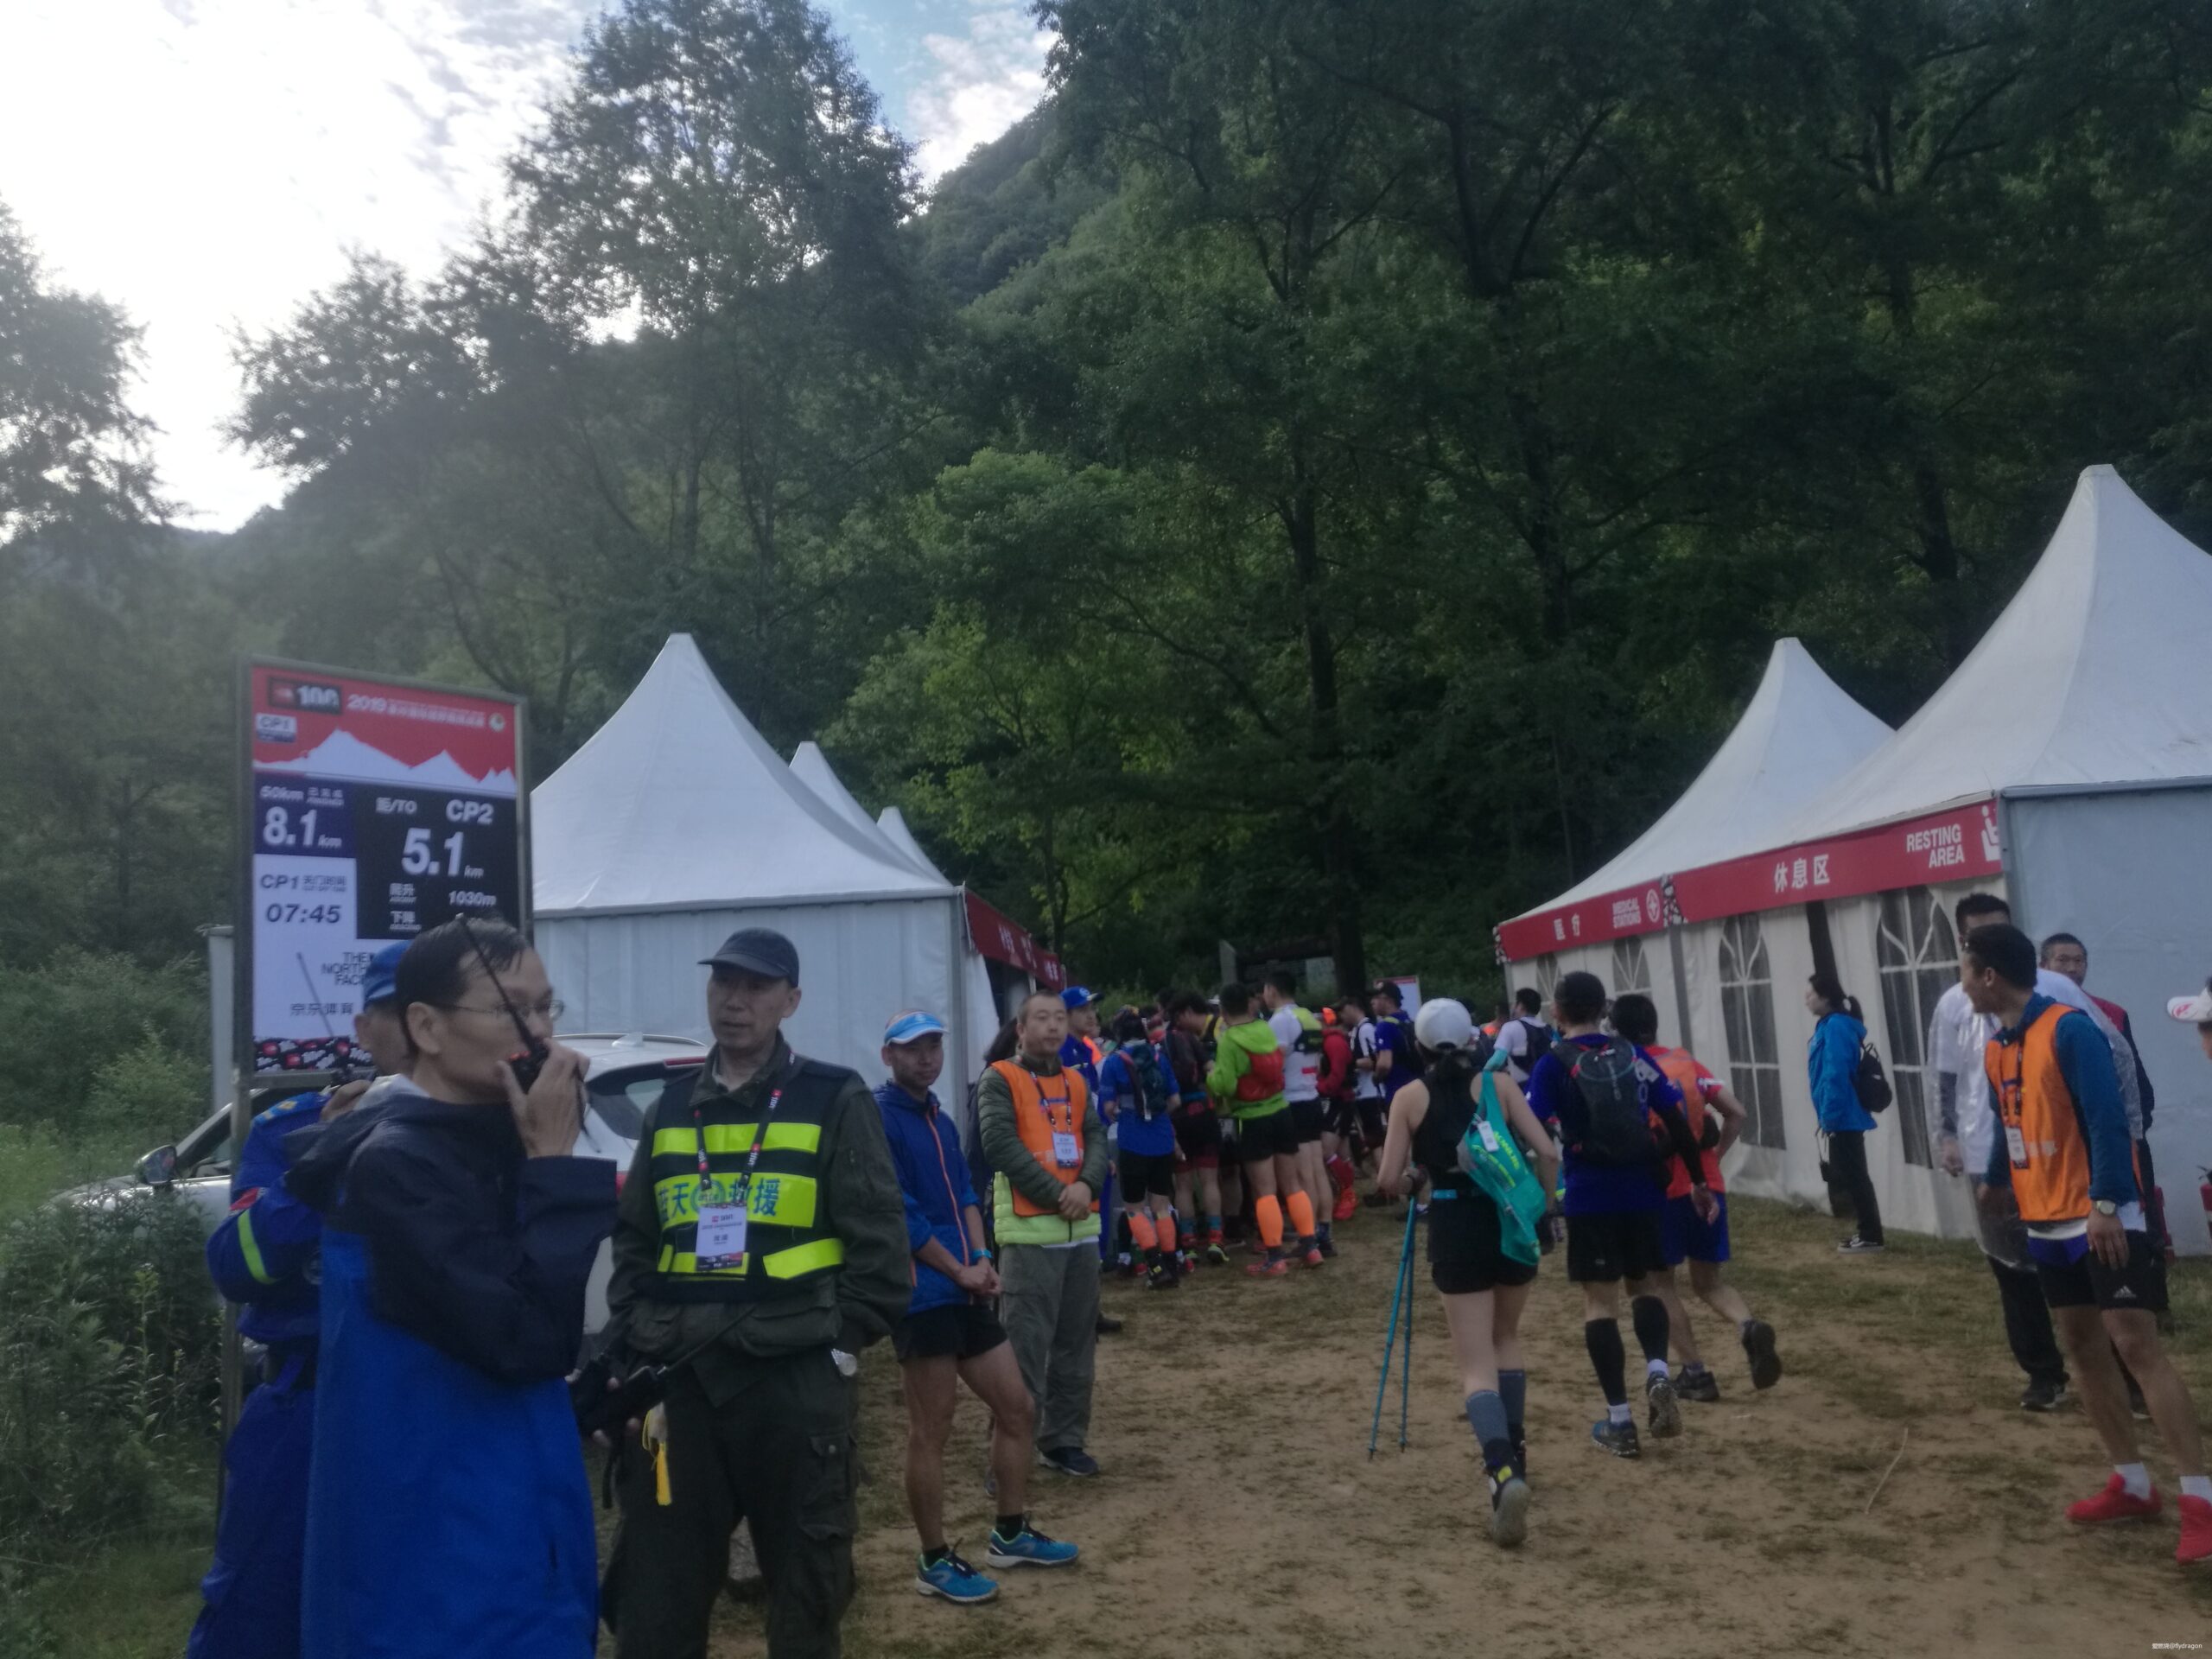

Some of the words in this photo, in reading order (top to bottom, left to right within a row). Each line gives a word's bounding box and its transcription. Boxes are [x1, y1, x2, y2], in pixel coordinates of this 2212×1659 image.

[446, 799, 493, 824] CP2
[263, 806, 317, 846] 8.1
[1906, 823, 1962, 853] RESTING
[402, 827, 464, 877] 5.1
[1929, 844, 1965, 868] AREA
[261, 874, 299, 890] CP1
[1774, 854, 1830, 893] 休息区
[449, 891, 497, 907] 1030m
[266, 904, 341, 923] 07:45
[343, 952, 367, 963] THE
